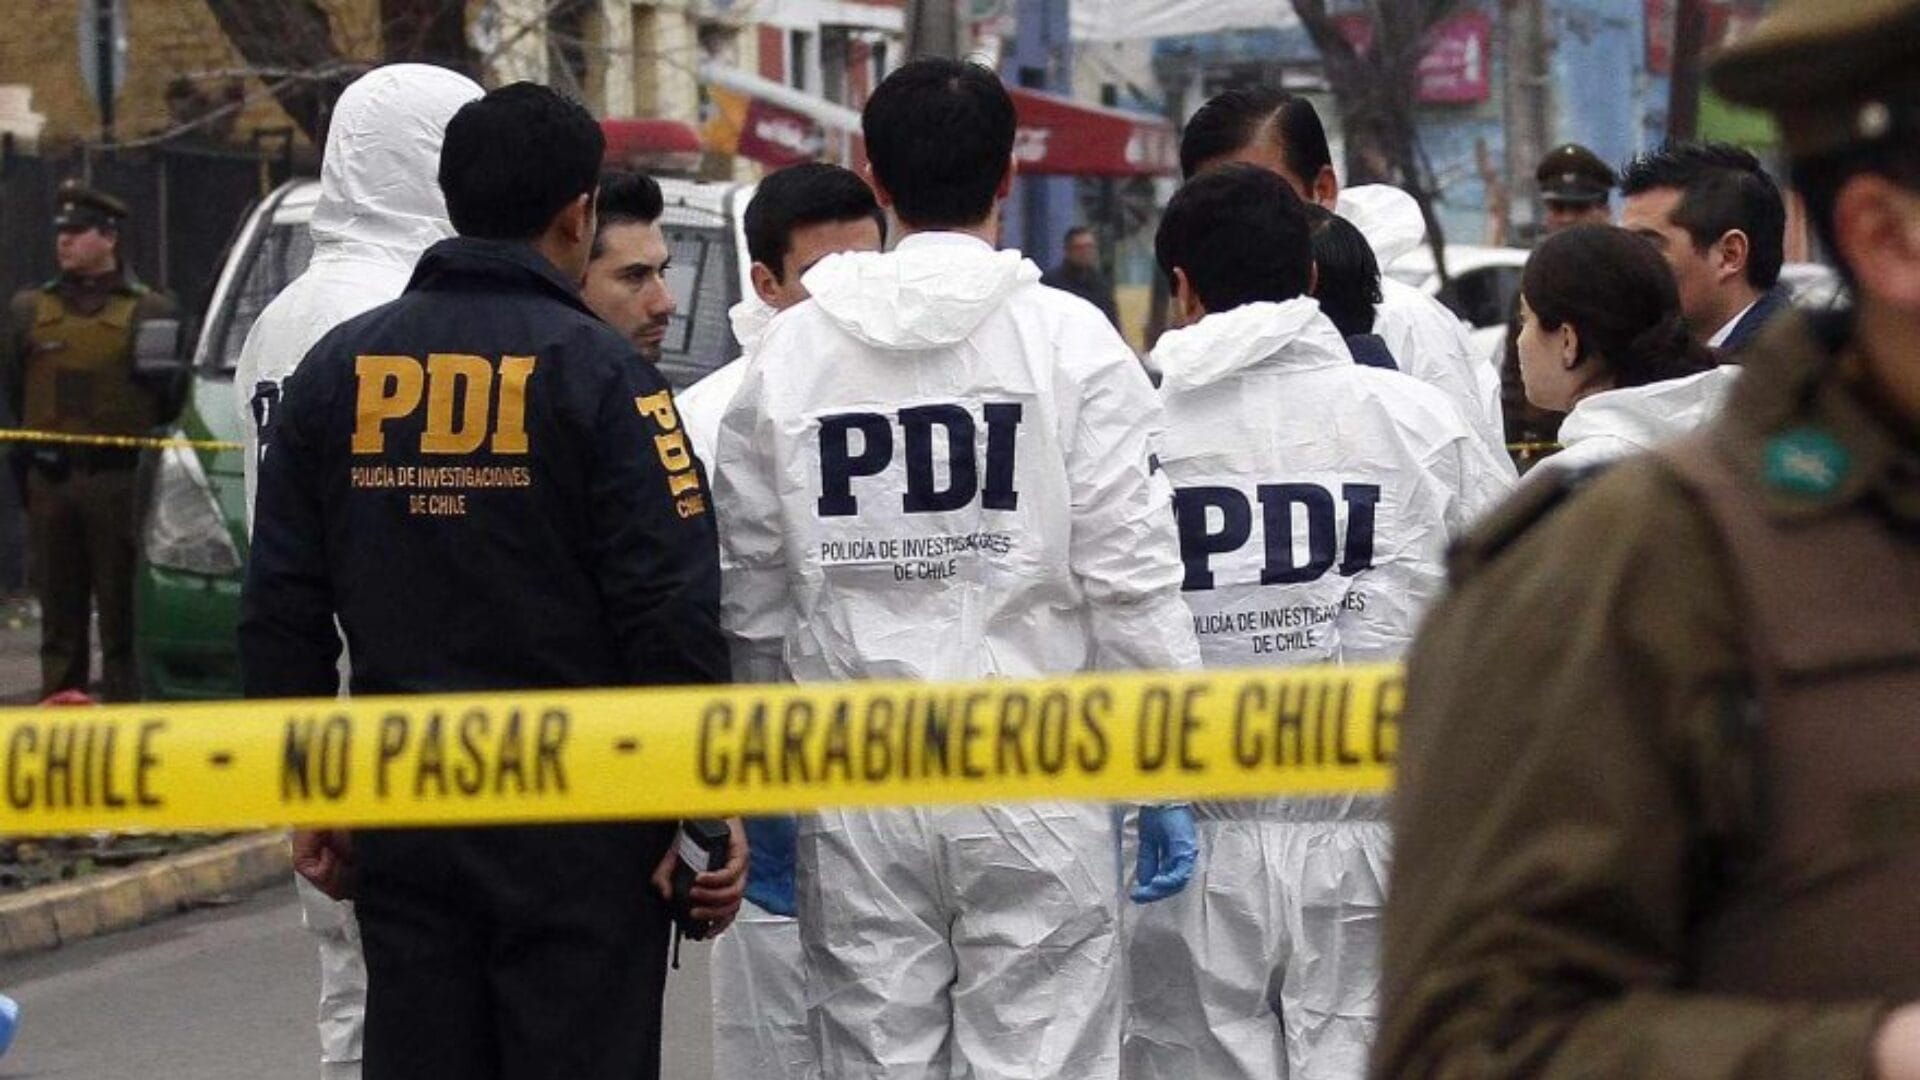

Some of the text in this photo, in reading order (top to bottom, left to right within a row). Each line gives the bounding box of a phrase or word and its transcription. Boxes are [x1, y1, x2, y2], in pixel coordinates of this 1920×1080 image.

[351, 353, 537, 454] PDI
[634, 389, 700, 497] PDI
[816, 402, 1022, 517] PDI
[351, 464, 532, 488] POLICÍA DE INVESTIGACIONES
[409, 494, 467, 515] DE CHILE
[821, 536, 876, 562] POLICÍA
[879, 538, 899, 559] DE
[1169, 482, 1381, 591] PDI
[894, 558, 957, 581] DE CHILE
[1193, 590, 1367, 634] LICÍA DE INVESTIGAES
[1252, 628, 1317, 654] DE CHILE
[7, 720, 166, 810] CHILE
[280, 713, 352, 801] NO
[377, 705, 571, 798] PASAR
[698, 688, 1114, 789] CARABINEROS
[1134, 682, 1210, 773] DE
[1233, 676, 1406, 769] CHILE
